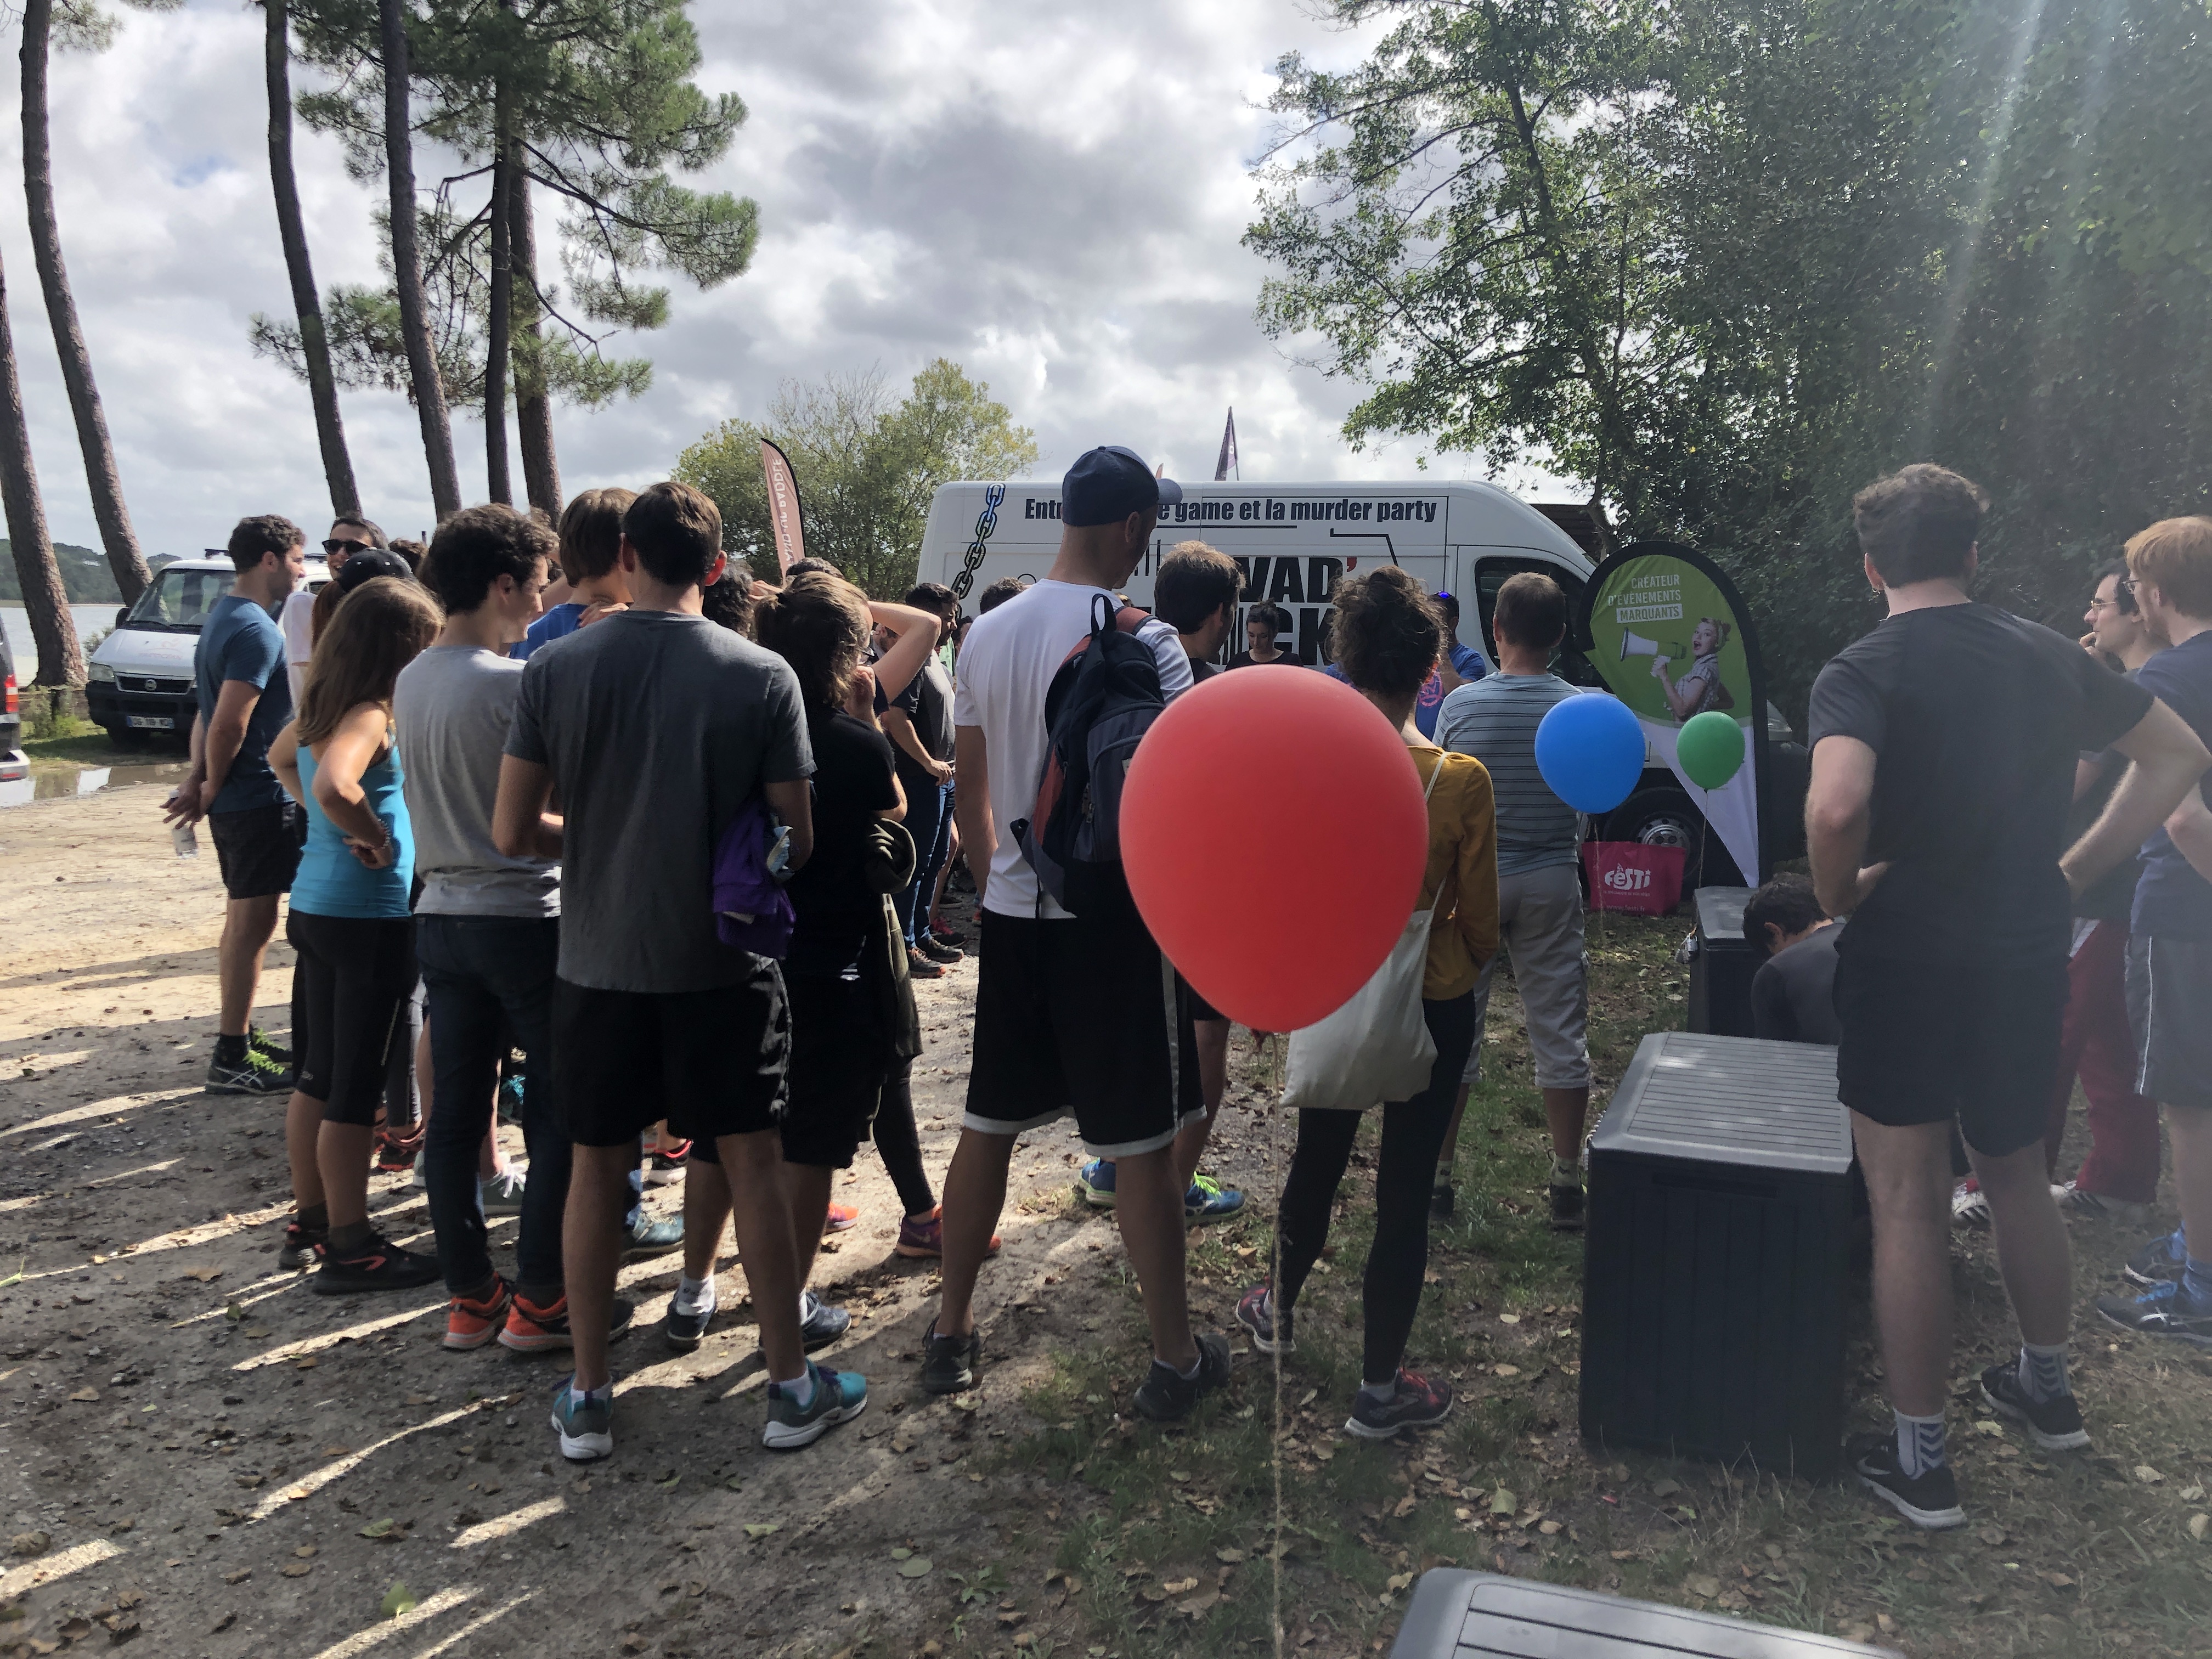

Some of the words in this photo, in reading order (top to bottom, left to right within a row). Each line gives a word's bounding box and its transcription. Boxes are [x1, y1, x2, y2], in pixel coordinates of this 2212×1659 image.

[1025, 498, 1063, 520] Entr
[1175, 501, 1234, 523] game
[1239, 500, 1261, 521] et
[1265, 499, 1285, 521] la
[1291, 499, 1373, 521] murder
[1377, 500, 1437, 523] party
[1233, 556, 1357, 602] VAD'
[1631, 574, 1680, 589] CRÉATEUR
[1620, 606, 1680, 621] MARQUANTS
